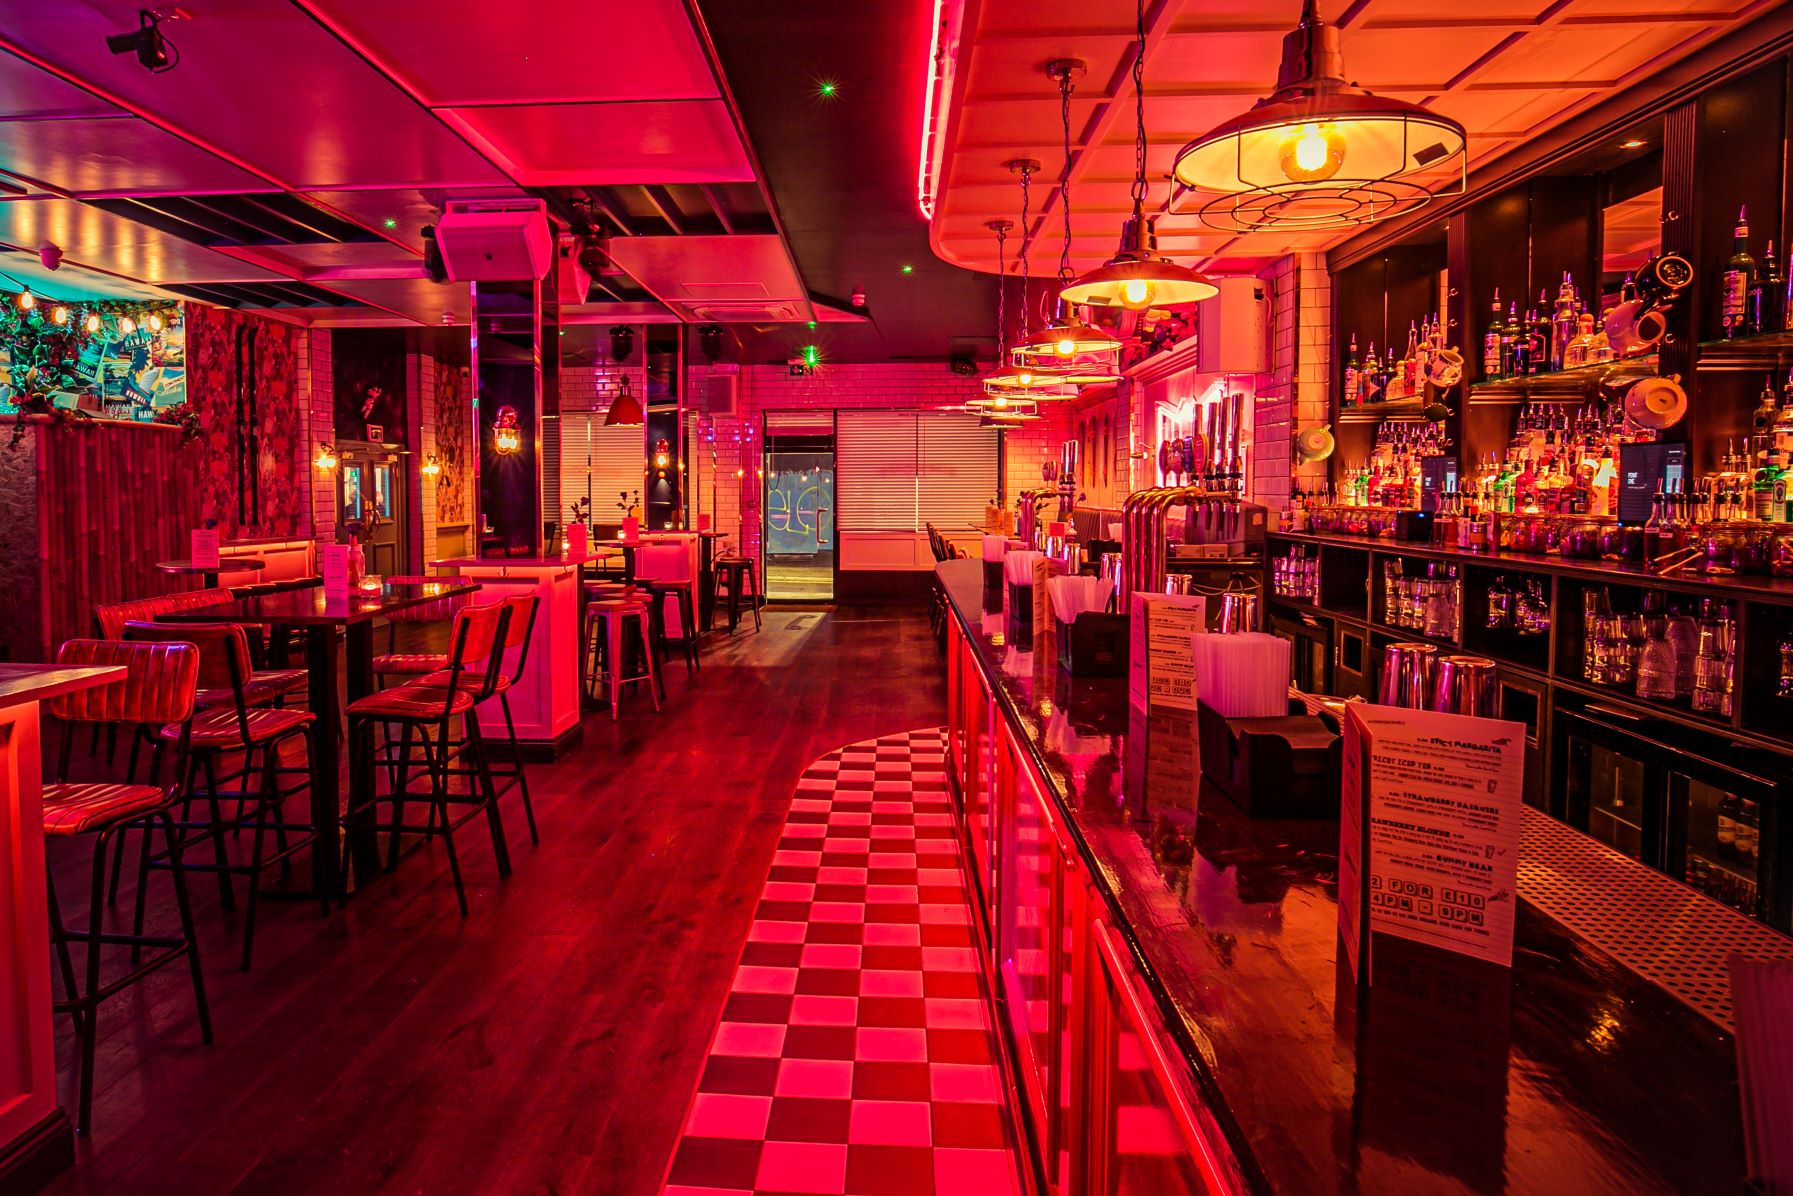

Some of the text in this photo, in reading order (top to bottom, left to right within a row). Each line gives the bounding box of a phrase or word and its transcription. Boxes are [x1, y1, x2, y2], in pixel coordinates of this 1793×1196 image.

[75, 364, 95, 377] AWAII
[138, 410, 153, 419] HAW
[1454, 740, 1502, 754] MARGARITA
[1372, 754, 1396, 765] RICOT
[1397, 757, 1416, 768] ICED
[1403, 791, 1455, 807] STRAWBERRY
[1371, 817, 1416, 831] RAWBERRY
[1436, 854, 1467, 867] GUMMY
[1468, 861, 1494, 872] BEAR
[1392, 881, 1429, 895] FOR
[1445, 891, 1481, 906] £10
[1372, 894, 1409, 908] 4PM
[1442, 908, 1480, 923] 9PM
